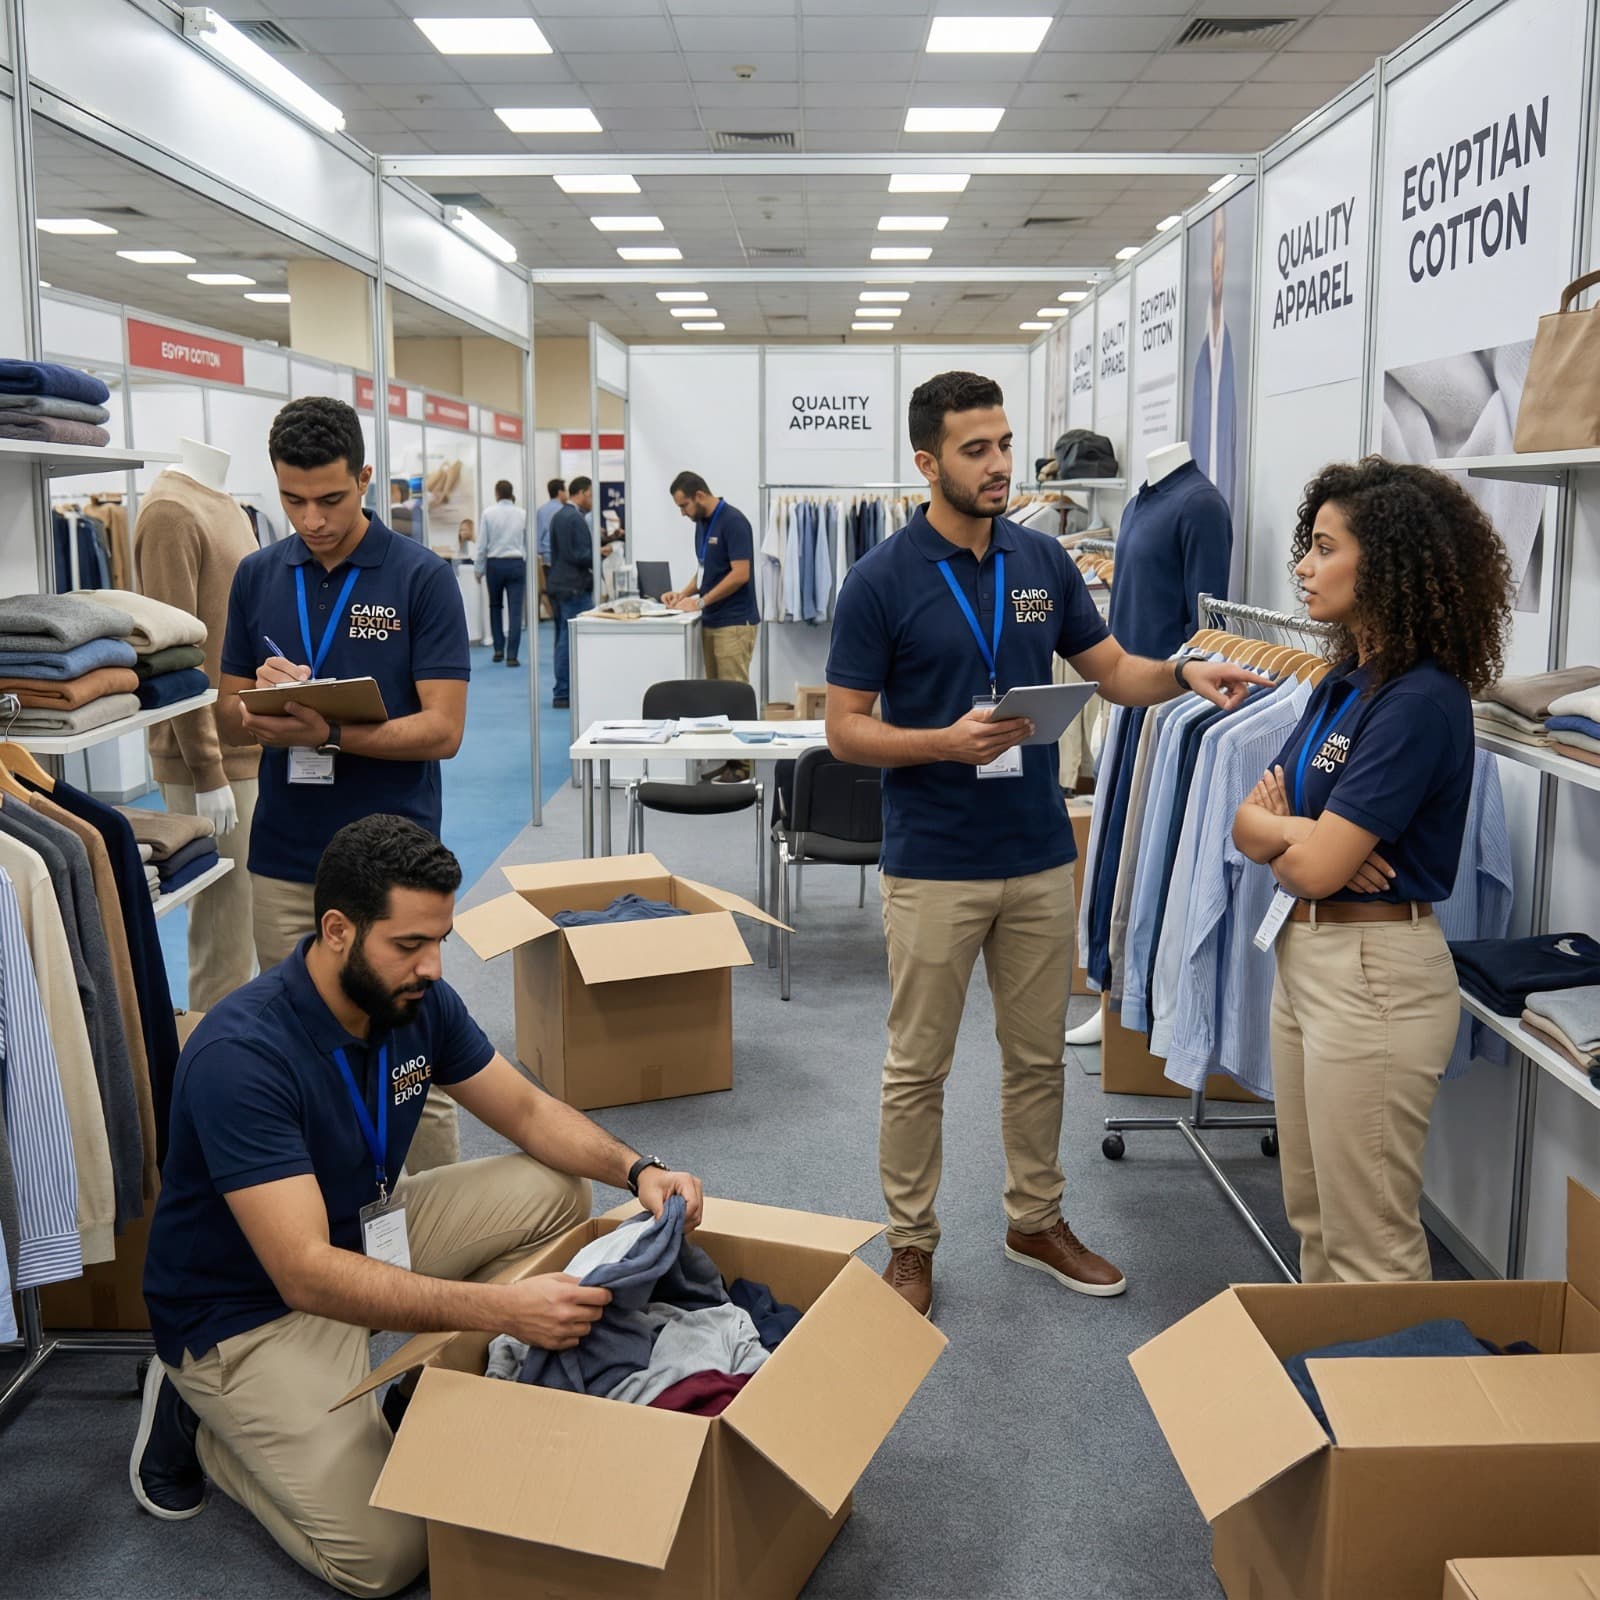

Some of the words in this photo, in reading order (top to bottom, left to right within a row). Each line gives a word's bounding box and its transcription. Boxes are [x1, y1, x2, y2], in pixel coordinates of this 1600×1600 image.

[1403, 95, 1549, 221] EGYPTIAN
[1278, 196, 1355, 280] QUALITY
[1409, 185, 1530, 283] COTTON
[1140, 283, 1177, 324] EGYPTIAN
[1273, 261, 1353, 329] APPAREL
[1143, 319, 1173, 351] COTTON
[792, 396, 869, 412] QUALITY
[789, 415, 872, 430] APPAREL
[1011, 589, 1048, 600] CAIRO
[1012, 599, 1054, 611] TEXTILE
[351, 604, 396, 618] CAIRO
[1016, 611, 1047, 623] EXPO
[349, 627, 389, 641] EXPO
[350, 615, 401, 631] TEXTILE
[391, 1055, 426, 1080] CAIRO
[392, 1065, 431, 1092] TEXTILE
[394, 1083, 422, 1105] EXPO
